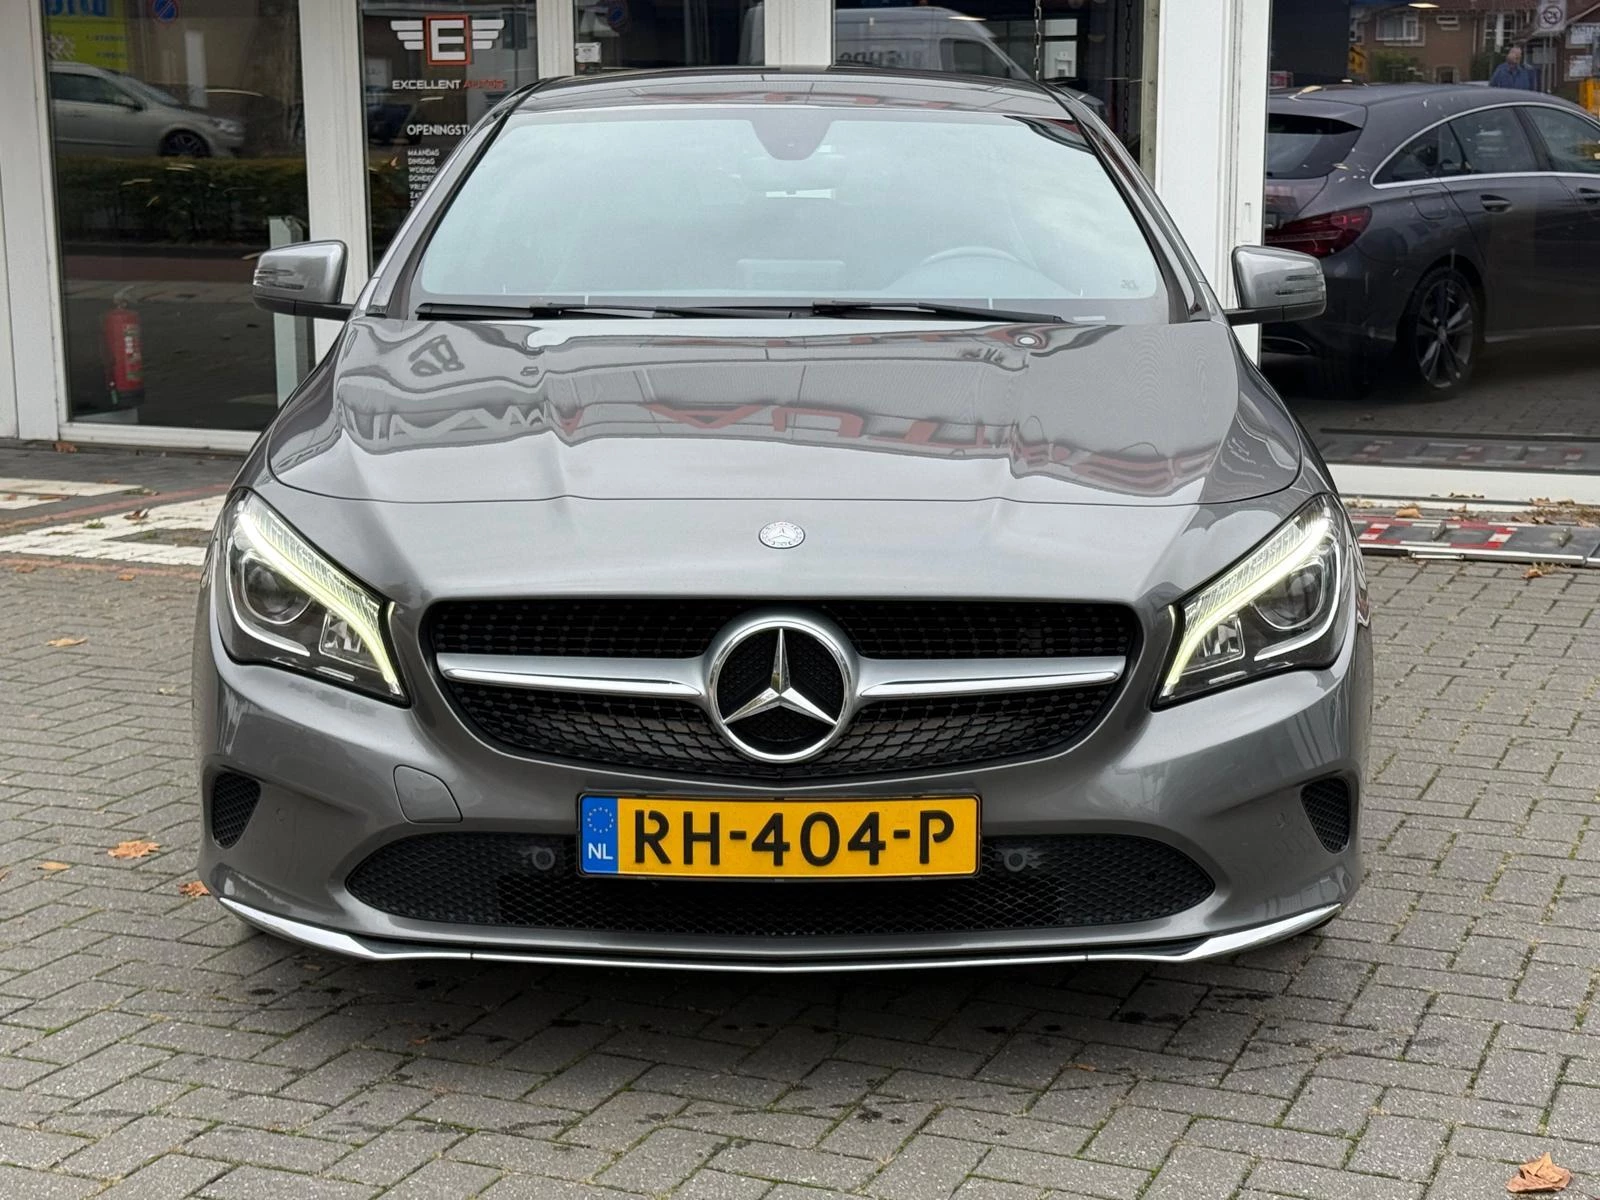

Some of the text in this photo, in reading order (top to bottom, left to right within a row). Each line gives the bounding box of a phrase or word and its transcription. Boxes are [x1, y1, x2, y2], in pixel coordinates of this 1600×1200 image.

[430, 20, 466, 61] E
[392, 80, 461, 90] EXCELLENT
[408, 148, 440, 156] MAANDAG
[634, 809, 954, 867] RH-404-P
[588, 843, 613, 860] NL
